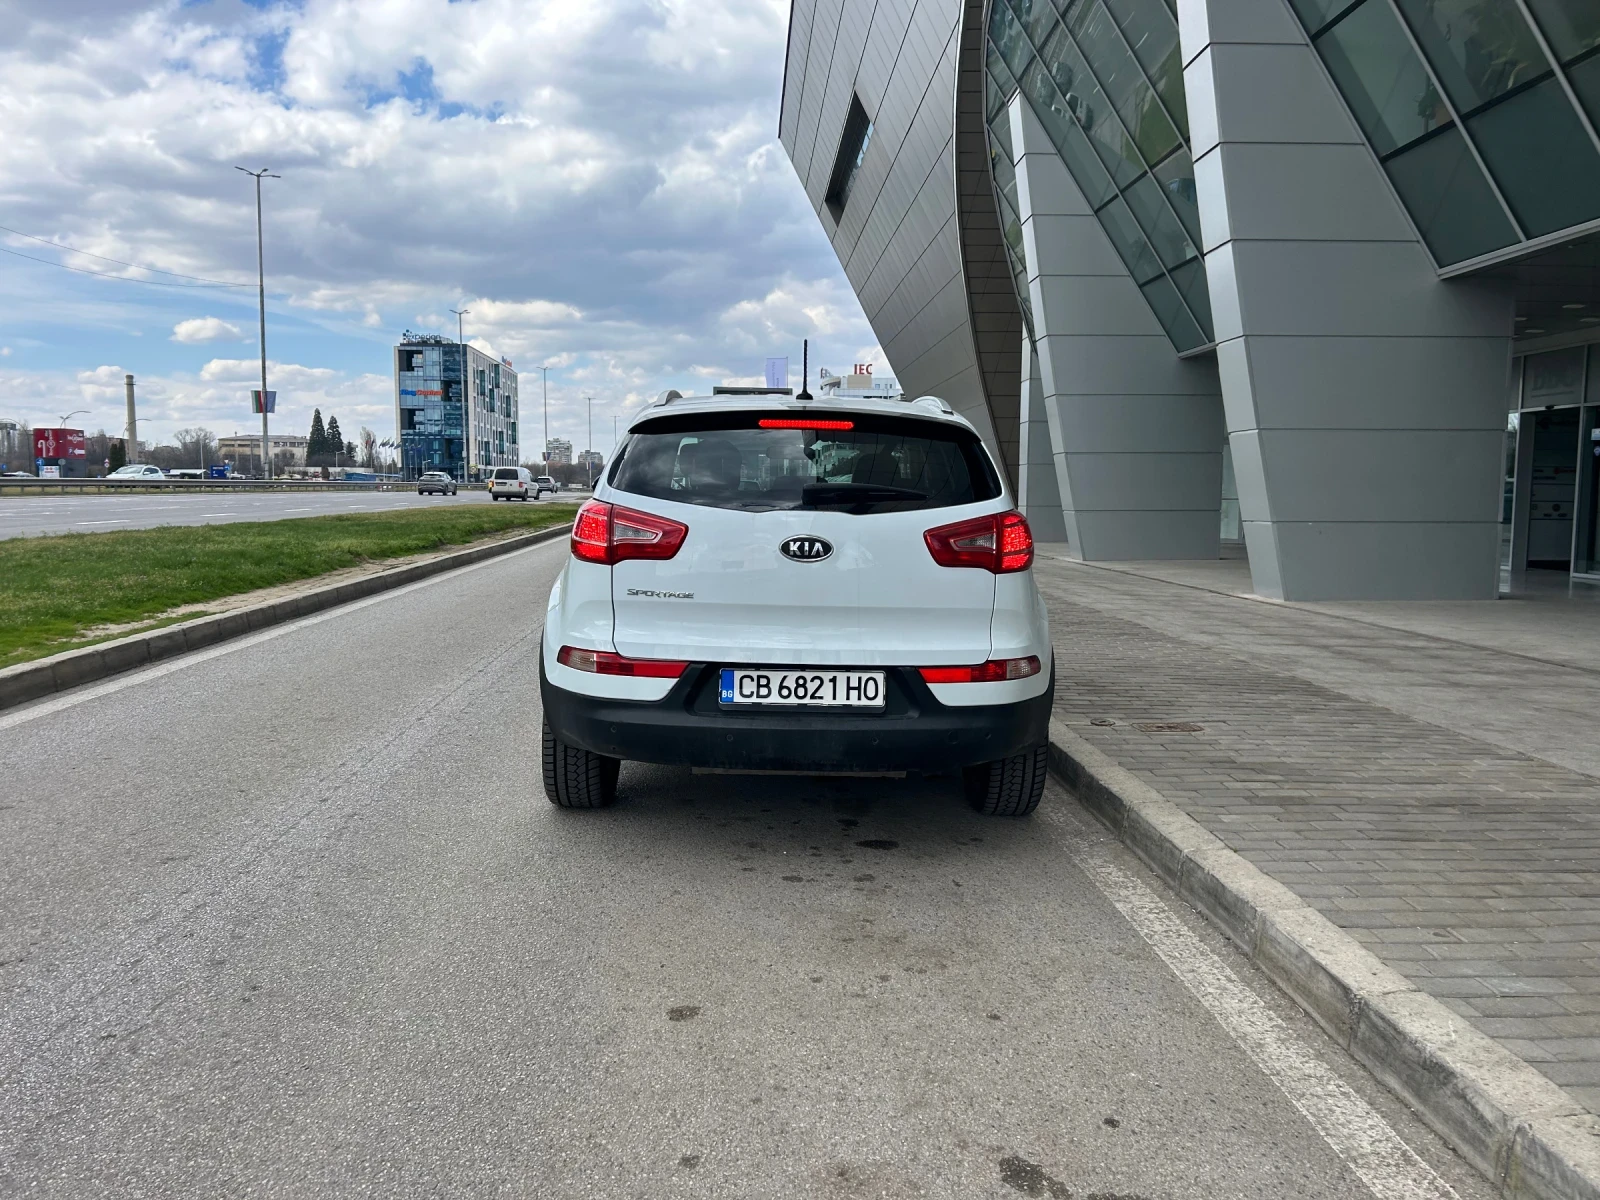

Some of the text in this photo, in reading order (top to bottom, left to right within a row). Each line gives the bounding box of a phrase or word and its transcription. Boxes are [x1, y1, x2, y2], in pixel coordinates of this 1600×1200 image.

[854, 363, 873, 375] IEC
[788, 540, 825, 556] KIA
[626, 588, 695, 599] SPORTAGE
[738, 674, 879, 702] CB 6821 HO
[721, 690, 733, 699] BG
